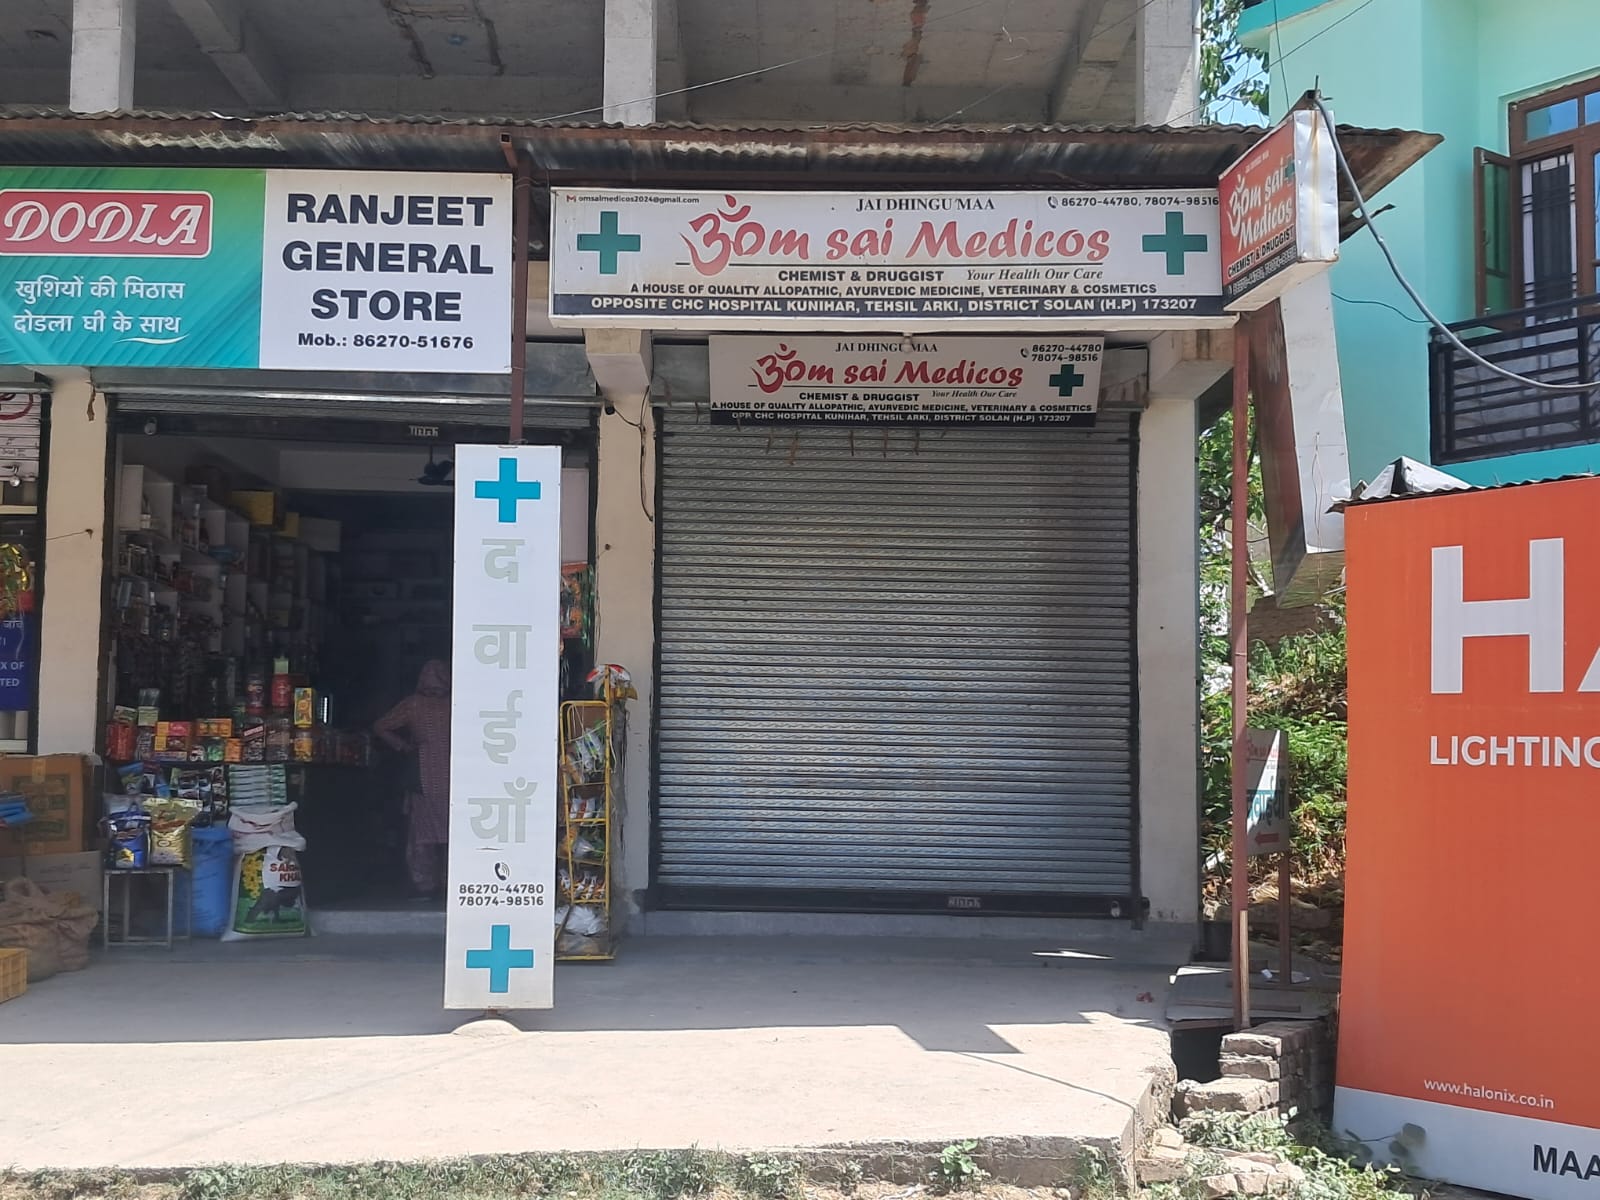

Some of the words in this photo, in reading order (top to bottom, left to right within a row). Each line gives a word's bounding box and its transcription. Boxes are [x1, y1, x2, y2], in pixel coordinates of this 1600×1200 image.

[1264, 157, 1285, 201] sai
[856, 198, 881, 211] JAI
[886, 198, 952, 211] DHINGU
[954, 198, 995, 211] MAA
[1061, 196, 1142, 208] 86270-44780,
[1144, 195, 1220, 207] 78074-98516
[286, 193, 494, 227] RANJEET
[3, 200, 204, 246] DODLA
[1238, 198, 1294, 254] Medicos
[826, 217, 894, 260] sai
[905, 217, 1111, 261] Medicos
[281, 241, 495, 276] GENERAL
[1227, 250, 1255, 278] CHEMIST
[1261, 226, 1294, 256] DRUGGIST
[778, 270, 848, 282] CHEMIST
[851, 270, 862, 282] &
[863, 270, 944, 282] DRUGGIST
[967, 268, 995, 281] Your
[998, 267, 1042, 281] Health
[1045, 267, 1070, 280] Our
[1073, 267, 1103, 280] Care
[15, 274, 84, 304] खुशियों
[89, 275, 118, 299] की
[123, 275, 186, 300] मिठास
[630, 283, 639, 294] A
[642, 283, 686, 295] HOUSE
[689, 284, 705, 295] OF
[708, 284, 761, 297] QUALITY
[763, 285, 842, 297] ALLOPATHIC,
[846, 285, 917, 296] AYURVEDIC
[919, 285, 985, 297] MEDICINE,
[988, 285, 1066, 295] VETERINARY
[1070, 284, 1079, 294] &
[1082, 284, 1157, 294] COSMETICS
[310, 288, 463, 322] STORE
[591, 297, 667, 311] OPPOSITE
[671, 298, 704, 311] CHC
[708, 299, 782, 312] HOSPITAL
[786, 299, 861, 313] KUNIHAR,
[864, 300, 918, 312] TEHSIL
[922, 300, 963, 313] ARKI,
[968, 300, 1040, 312] DISTRICT
[1043, 299, 1095, 312] SOLAN
[1100, 298, 1137, 312] (H.P)
[1142, 298, 1198, 311] 173207
[12, 309, 74, 334] दोडला
[82, 309, 107, 333] घी
[112, 310, 133, 333] के
[139, 315, 182, 334] साथ
[297, 332, 348, 347] Mob.:
[353, 334, 475, 350] 86270-51676
[835, 342, 854, 353] JAI
[1031, 344, 1102, 353] 86270-44780
[1031, 353, 1098, 362] 78074-98516
[843, 358, 887, 384] sai
[894, 359, 1024, 387] Medicos
[799, 392, 848, 401] CHEMIST
[851, 393, 860, 401] &
[862, 393, 920, 402] DRUGGIST
[931, 390, 950, 398] Your
[951, 390, 978, 398] Health
[979, 390, 996, 398] Our
[711, 401, 718, 409] A
[719, 402, 751, 410] HOUSE
[753, 402, 765, 410] OF
[767, 403, 805, 411] QUALITY
[808, 403, 865, 412] ALLOPATHIC,
[868, 404, 919, 412] AYURVEDIC
[921, 404, 968, 413] MEDICINE,
[971, 404, 1027, 412] VETERINARY
[1039, 404, 1093, 412] COSMETICS
[754, 412, 774, 420] CHC
[777, 412, 822, 420] HOSPITAL
[824, 413, 869, 421] KUNIHAR,
[871, 413, 905, 421] TEHSIL
[906, 414, 932, 422] ARKI,
[934, 414, 976, 422] DISTRICT
[979, 414, 1009, 422] SOLAN
[1013, 414, 1035, 423] (H.P)
[1038, 414, 1072, 423] 173207
[458, 883, 544, 895] 86270-44780
[458, 895, 544, 907] 78074-98516
[1423, 1079, 1555, 1110] www.halonix.co.in
